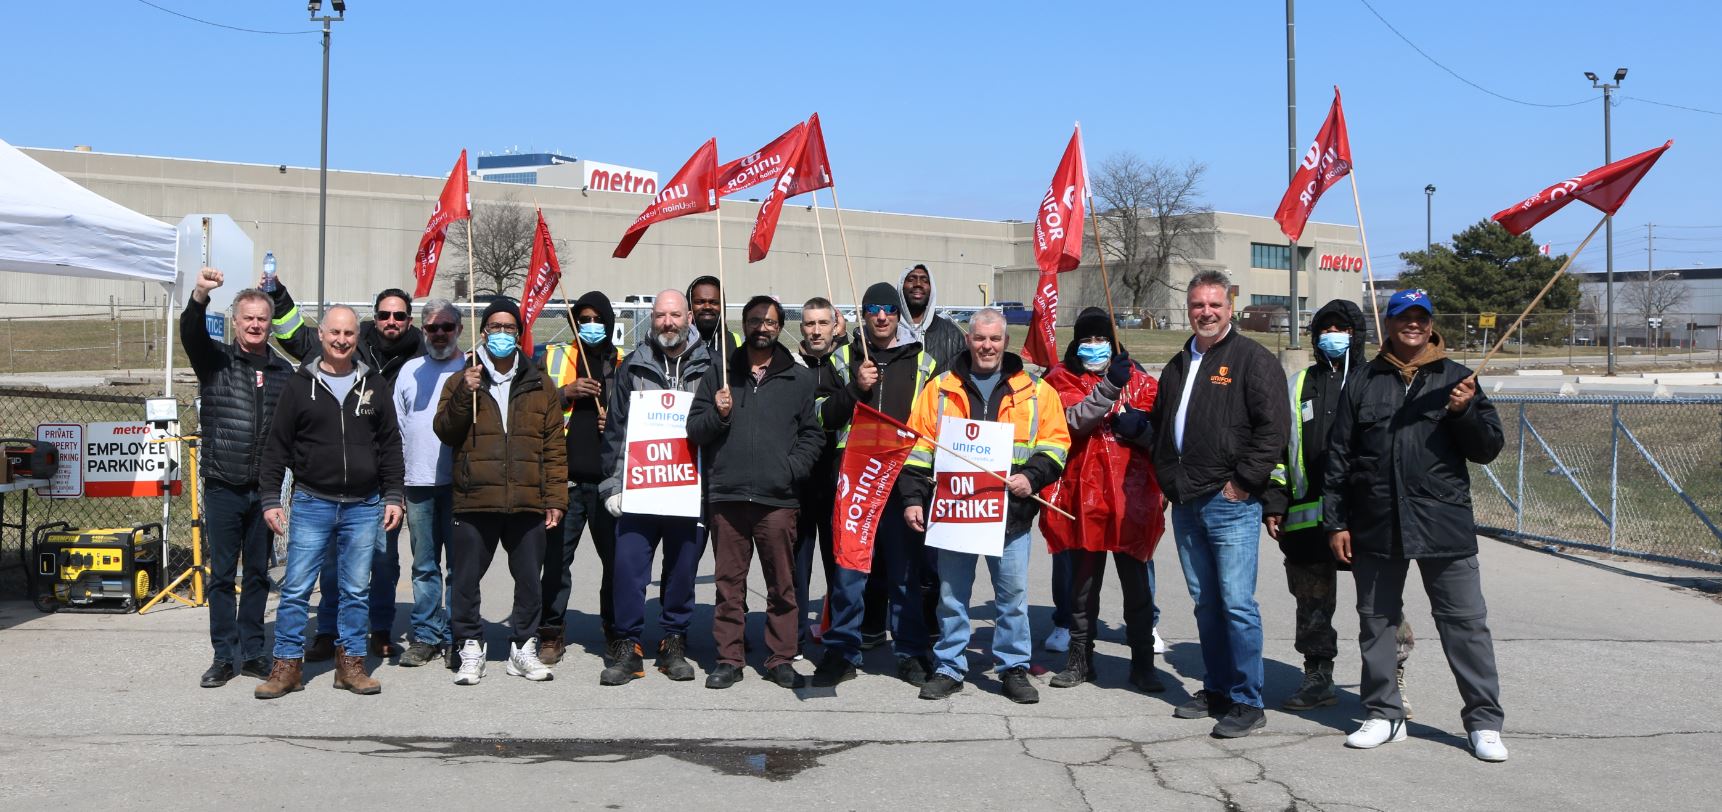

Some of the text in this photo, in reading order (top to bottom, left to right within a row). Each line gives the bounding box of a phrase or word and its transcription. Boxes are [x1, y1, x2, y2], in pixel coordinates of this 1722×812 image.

[590, 168, 656, 194] metro
[1043, 185, 1064, 241] NIFOR
[1319, 253, 1363, 271] metro
[207, 317, 224, 335] TICE
[648, 412, 685, 422] UNIFOR
[45, 430, 74, 439] PRIVATE
[113, 426, 150, 435] metro
[60, 453, 79, 461] RKING
[88, 442, 165, 456] EMPLOYEE
[647, 443, 672, 461] ON
[953, 442, 991, 455] UNIFOR
[88, 459, 155, 473] PARKING
[632, 463, 694, 484] STRIKE
[950, 476, 974, 495] ON
[936, 498, 999, 518] STRIKE
